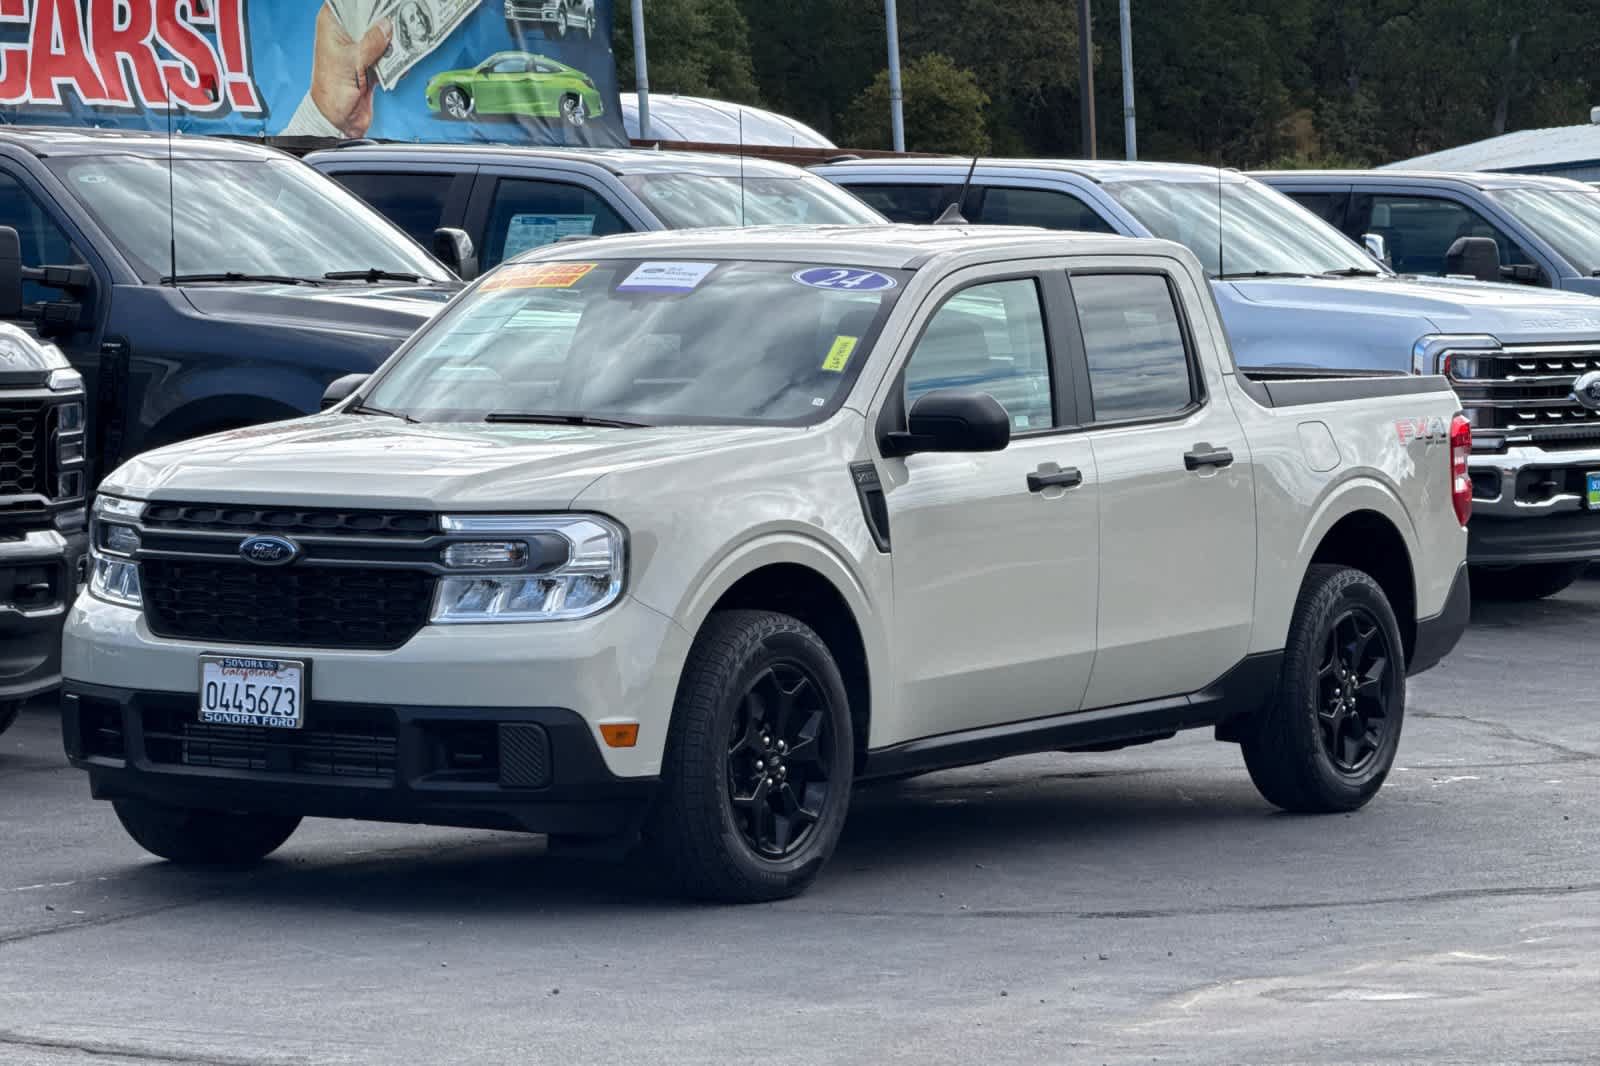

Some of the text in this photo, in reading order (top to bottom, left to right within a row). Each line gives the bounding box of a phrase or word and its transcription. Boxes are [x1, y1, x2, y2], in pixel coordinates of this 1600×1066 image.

[250, 542, 282, 559] Ford
[224, 658, 263, 669] SONORA
[204, 712, 296, 728] SONORA FORD
